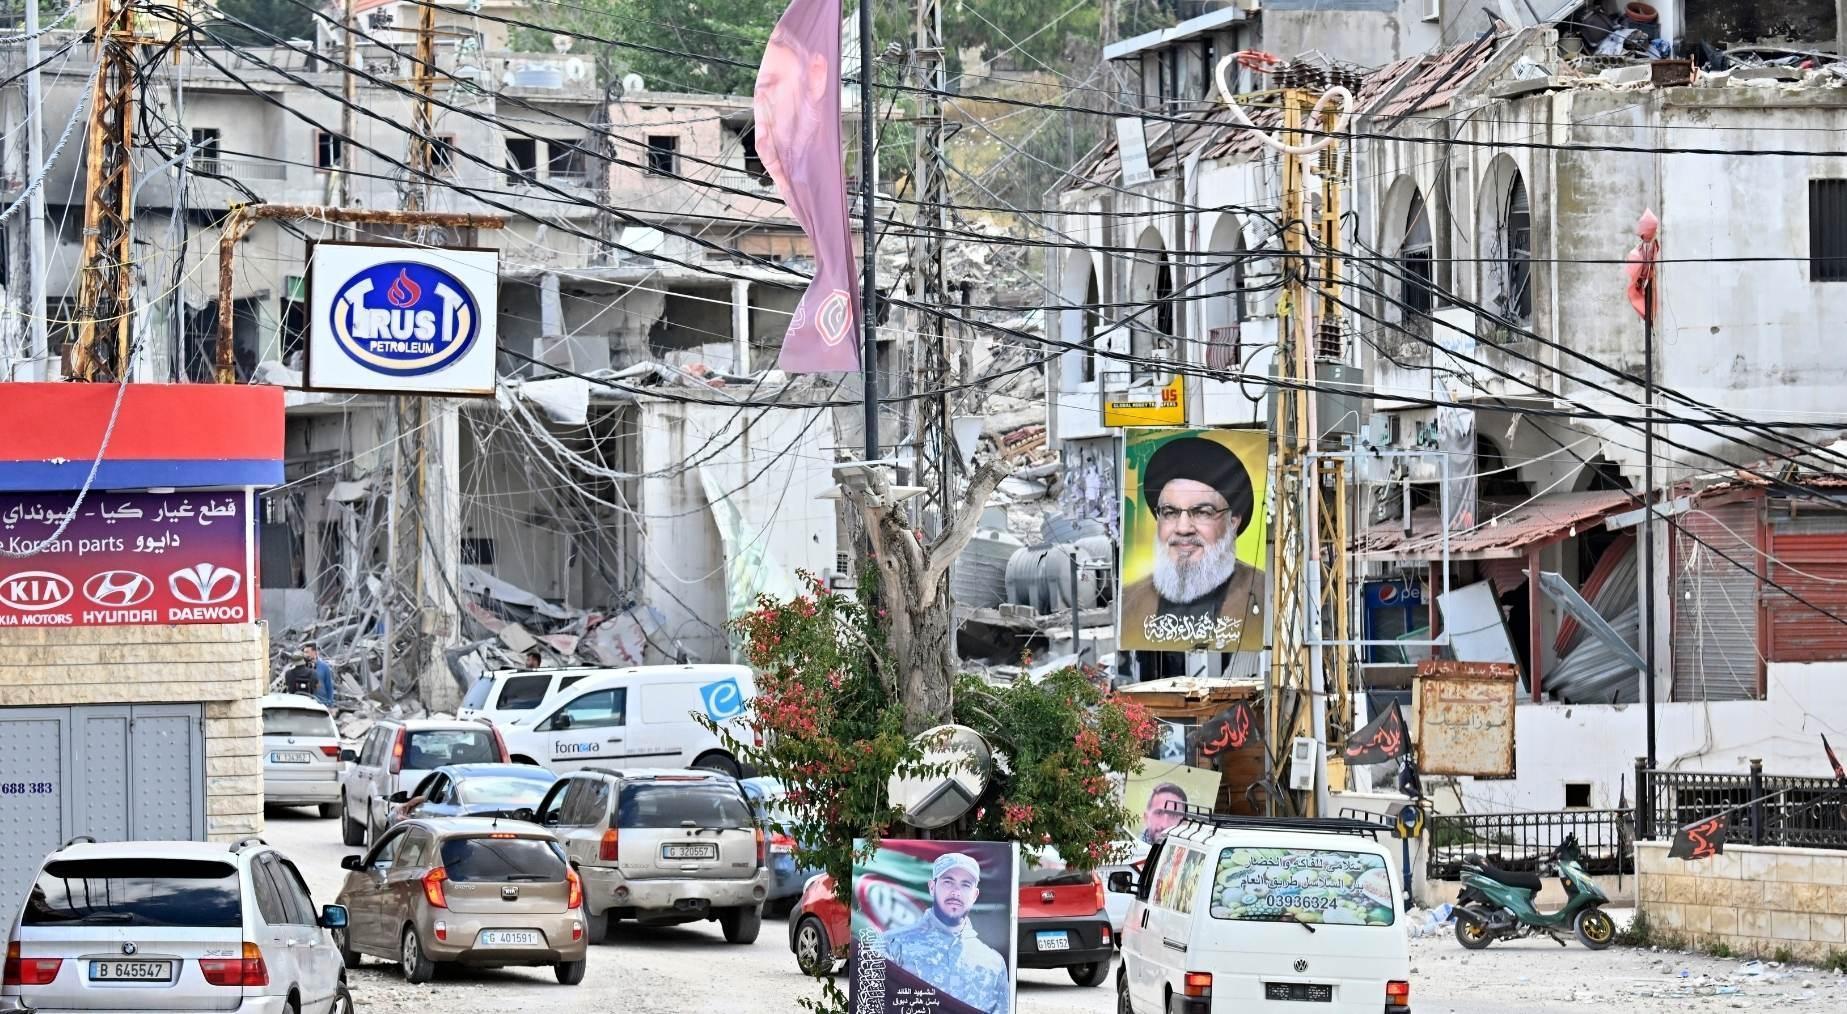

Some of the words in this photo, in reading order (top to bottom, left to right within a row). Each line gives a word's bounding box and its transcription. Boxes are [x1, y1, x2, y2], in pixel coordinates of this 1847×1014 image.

[344, 277, 465, 342] TRUST
[369, 341, 434, 354] PETROLEUM
[100, 502, 143, 524] كيا
[151, 499, 194, 522] غيار
[198, 498, 236, 526] قطع
[79, 537, 124, 556] parts
[132, 529, 180, 554] دايوو
[10, 581, 62, 601] KIA
[22, 614, 73, 625] MOTORS
[83, 611, 157, 623] HYUNDAI
[169, 607, 244, 620] DAEWOO
[2, 783, 25, 794] 688
[29, 783, 52, 793] 383
[670, 847, 676, 856] G
[680, 847, 709, 856] 320557
[1266, 895, 1338, 909] 03936324
[489, 933, 496, 943] G
[500, 933, 532, 944] 401591
[100, 964, 108, 977] B
[115, 964, 162, 977] 645547
